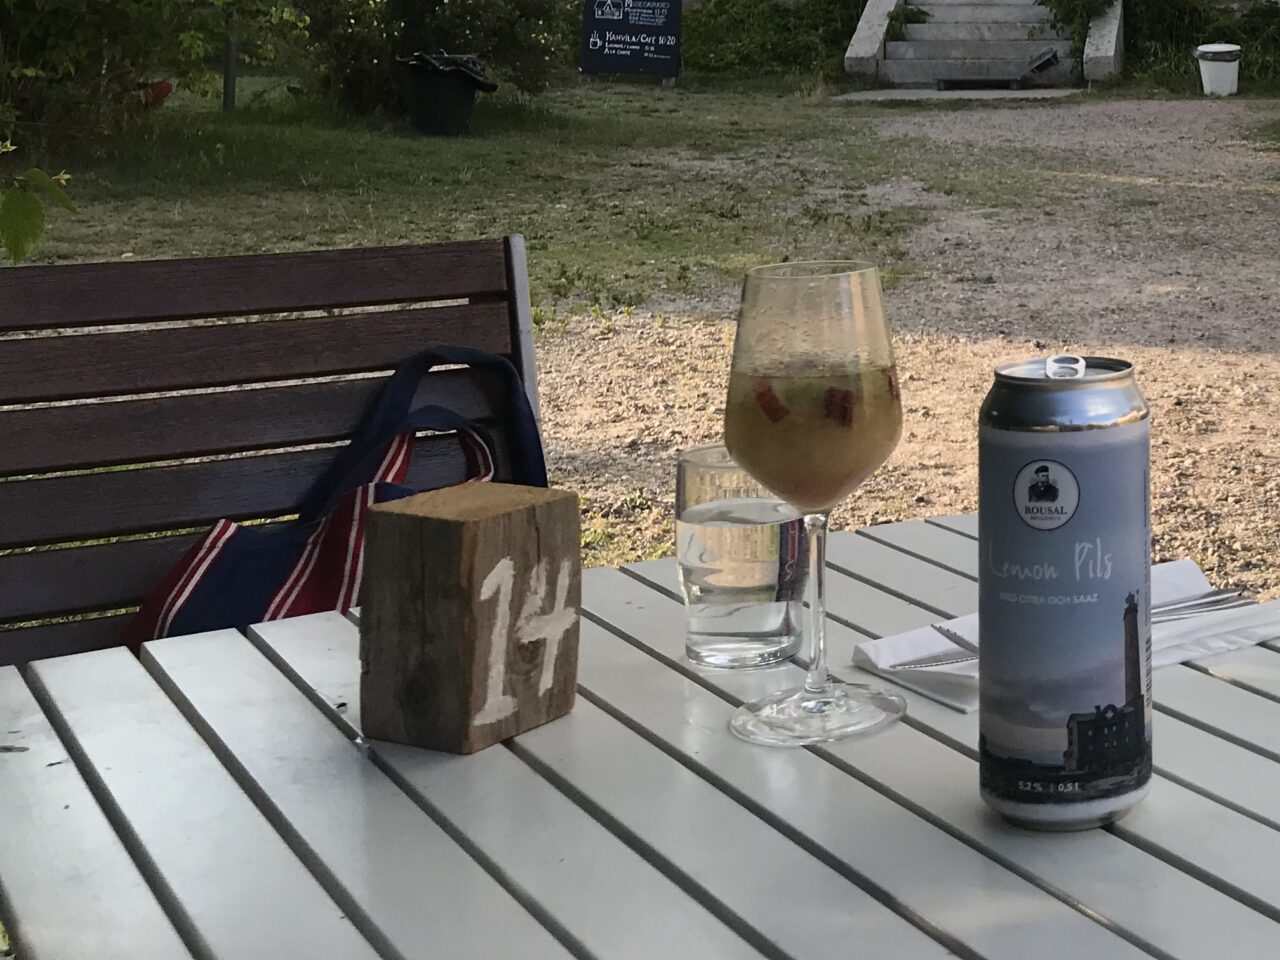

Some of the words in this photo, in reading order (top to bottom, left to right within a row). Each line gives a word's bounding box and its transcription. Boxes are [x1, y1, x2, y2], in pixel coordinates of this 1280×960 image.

[1025, 506, 1067, 515] ROUSAL
[989, 540, 1058, 581] Lemon
[1074, 538, 1113, 581] Pils
[1072, 592, 1098, 604] SAAZ
[473, 555, 577, 726] 14
